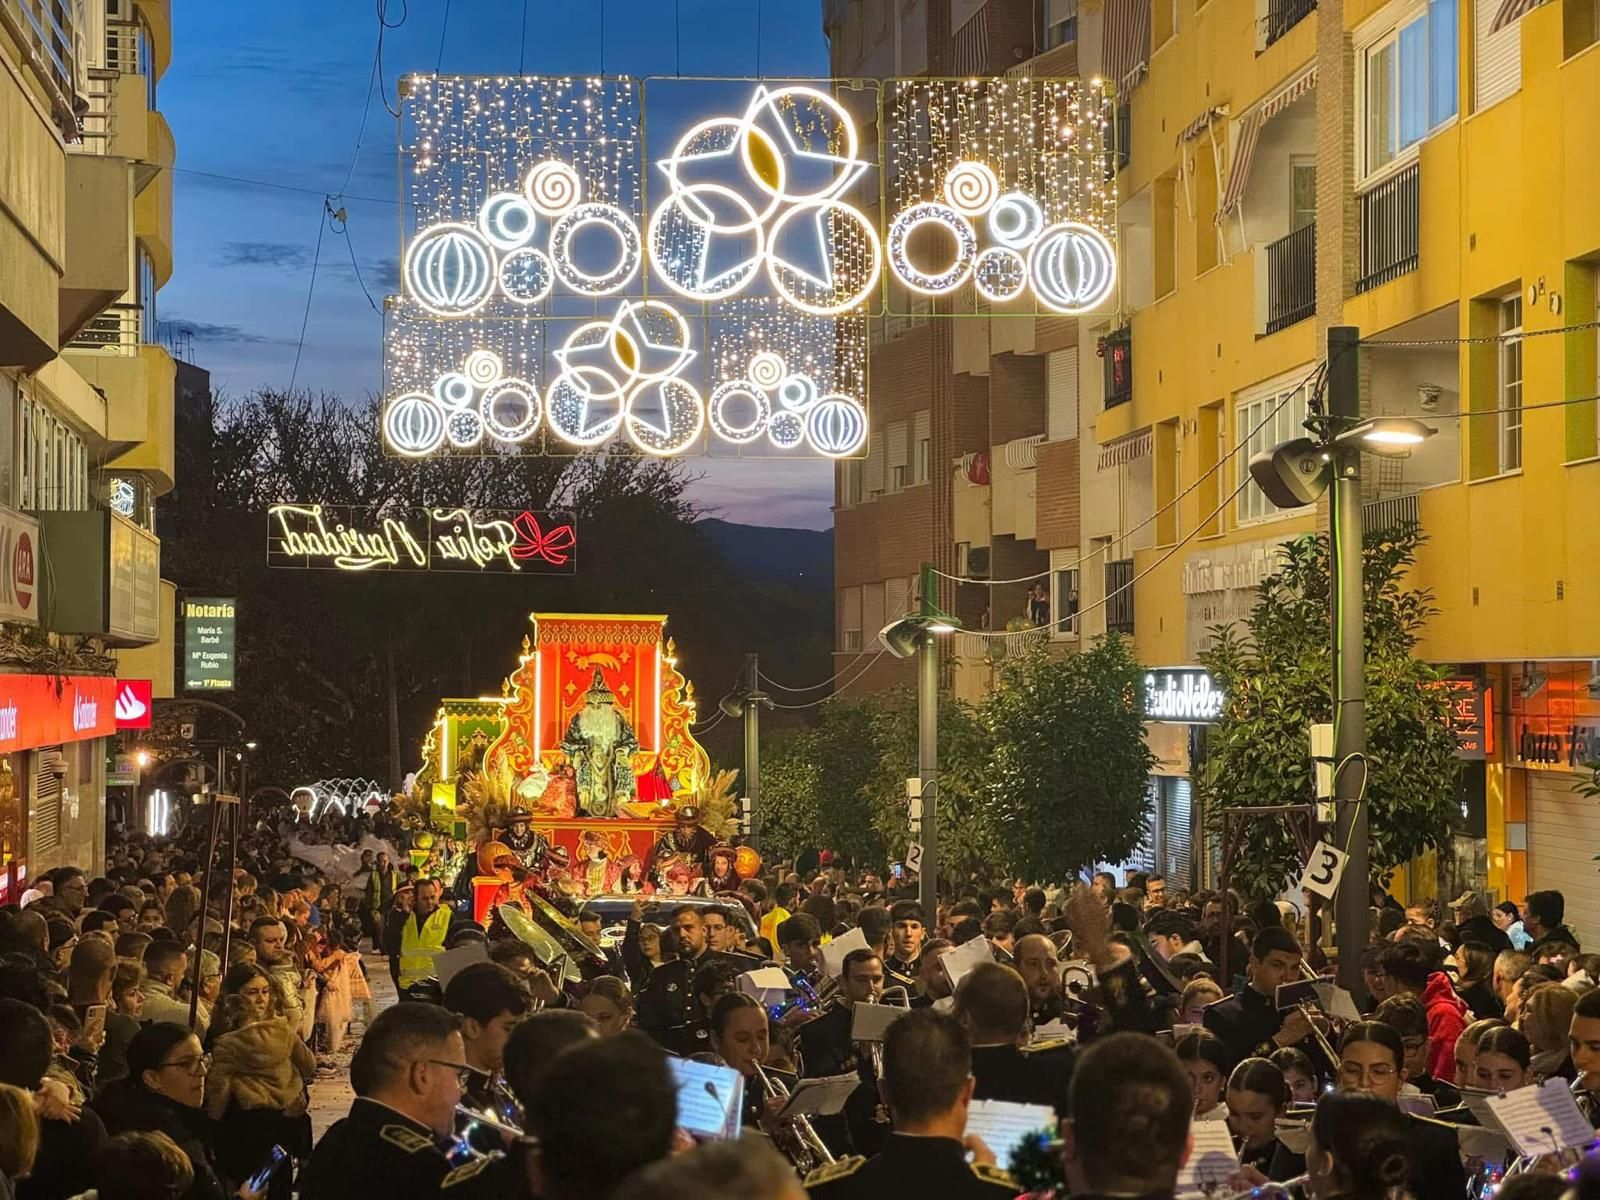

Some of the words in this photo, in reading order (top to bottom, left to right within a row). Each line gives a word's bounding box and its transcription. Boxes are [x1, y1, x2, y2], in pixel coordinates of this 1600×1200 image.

[186, 603, 235, 618] Notaría
[200, 636, 220, 644] Barbé
[202, 652, 228, 660] Eugenia
[200, 661, 219, 669] Rubio
[911, 846, 920, 864] 2
[1310, 849, 1339, 885] 3
